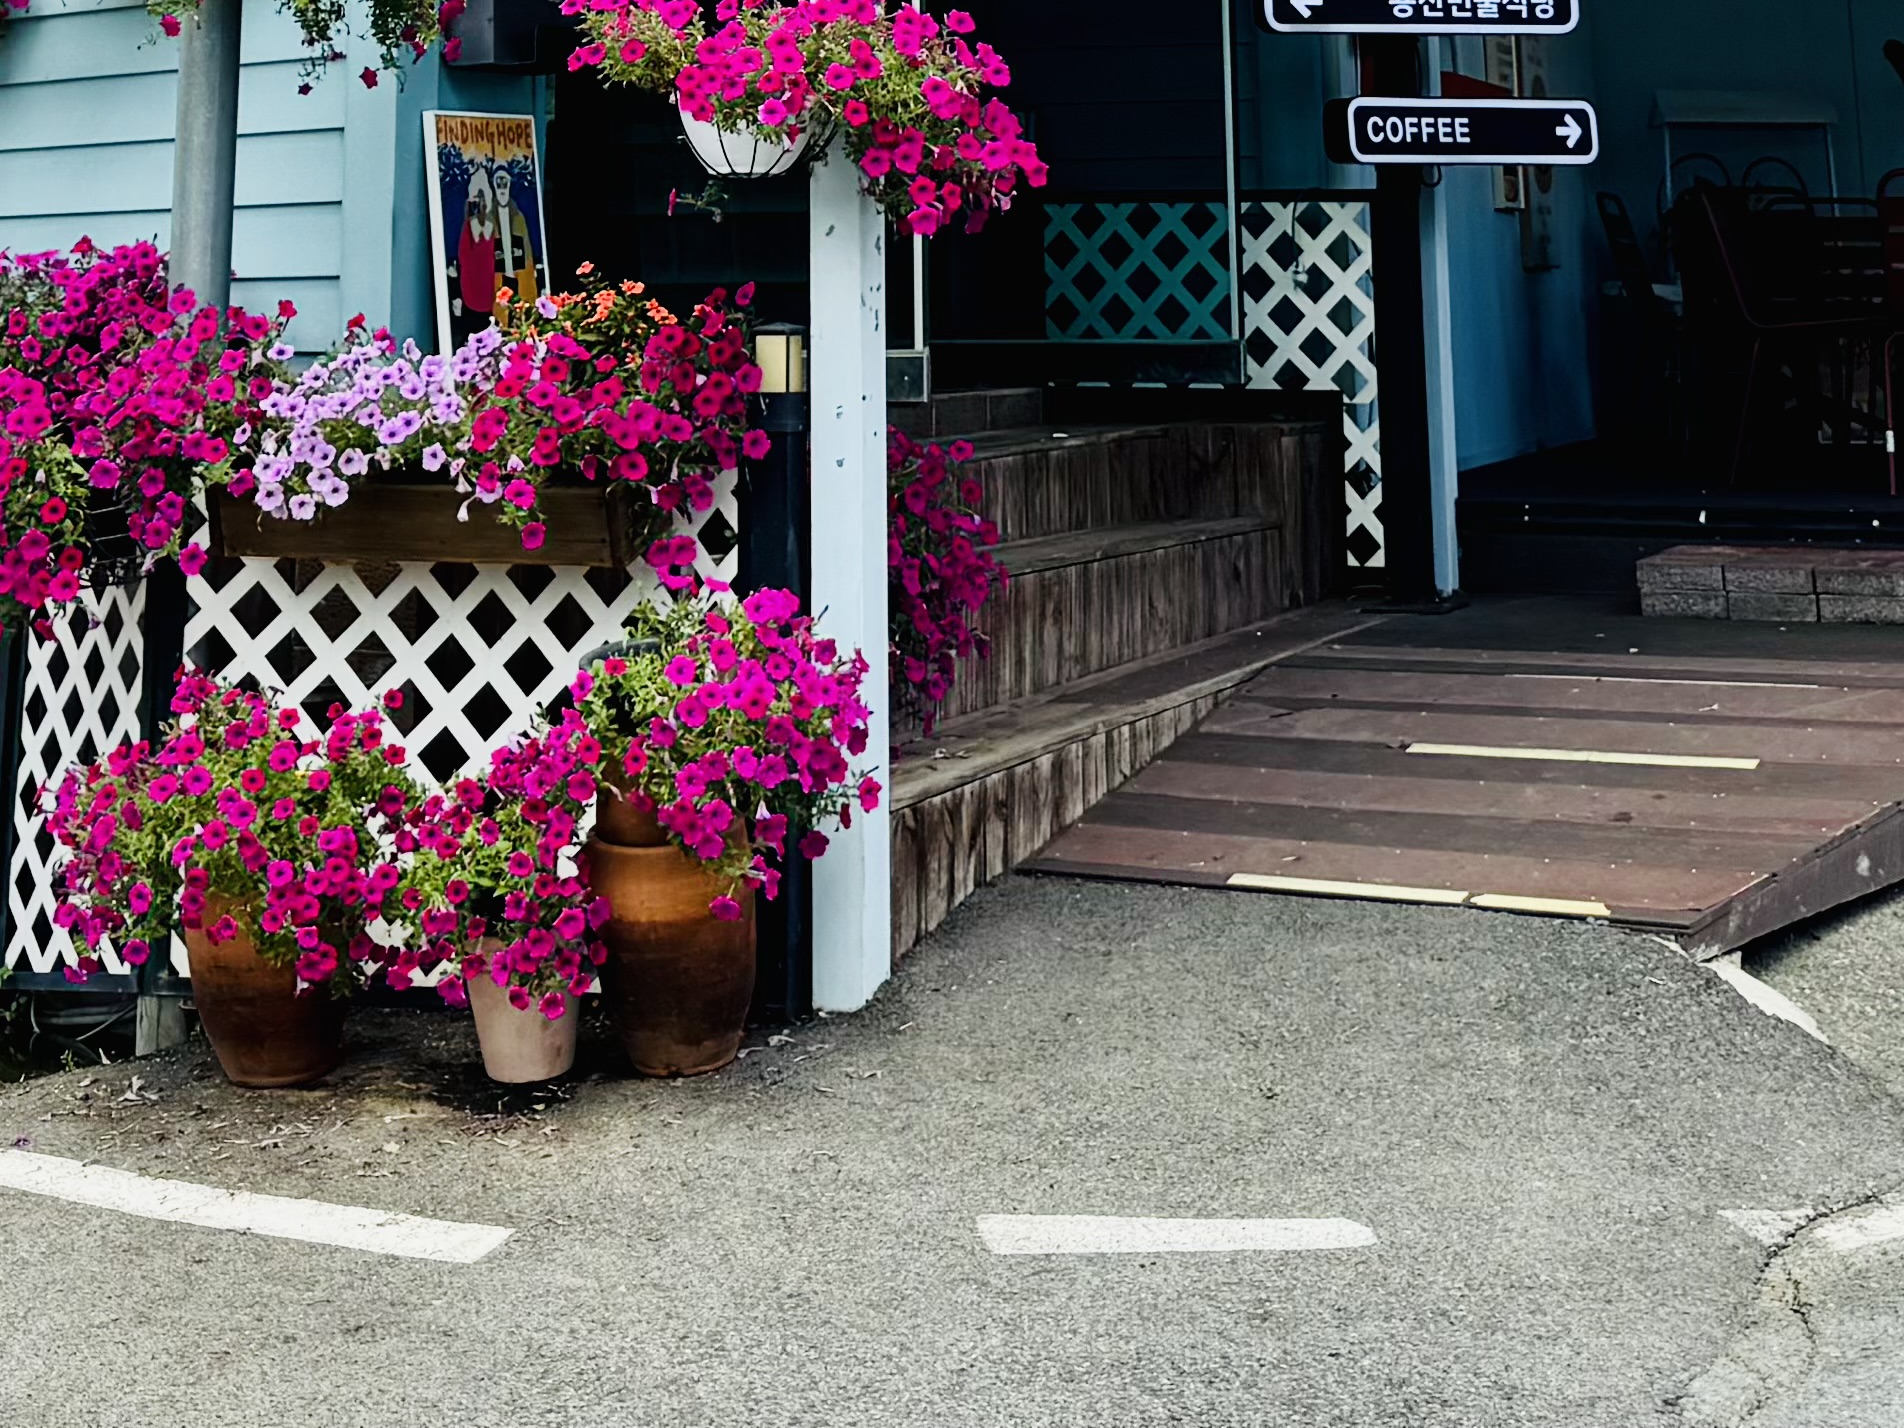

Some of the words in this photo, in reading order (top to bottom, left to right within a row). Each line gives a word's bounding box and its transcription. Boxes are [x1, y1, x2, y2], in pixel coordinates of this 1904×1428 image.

[436, 118, 495, 154] FINDING
[496, 119, 533, 149] HOPE
[1367, 116, 1471, 143] COFFEE
